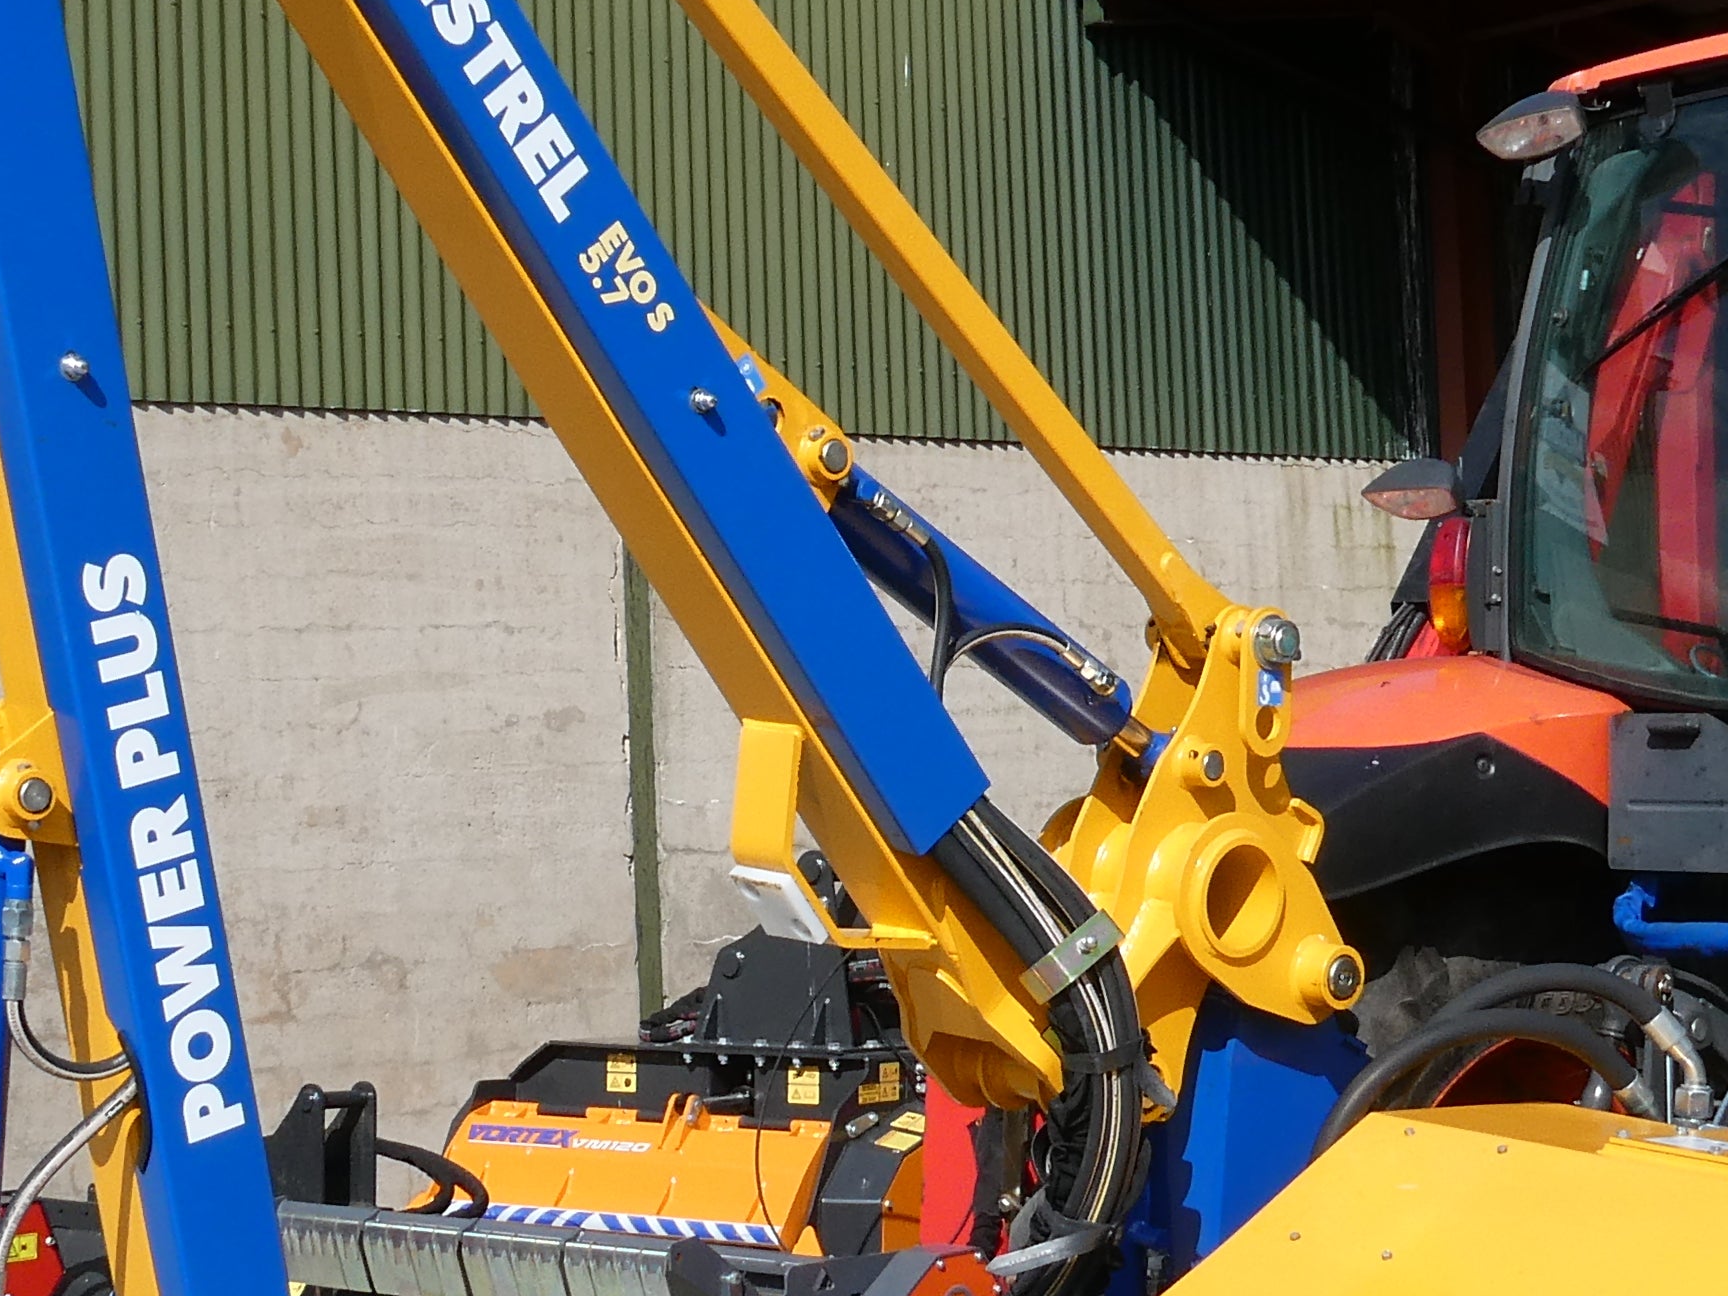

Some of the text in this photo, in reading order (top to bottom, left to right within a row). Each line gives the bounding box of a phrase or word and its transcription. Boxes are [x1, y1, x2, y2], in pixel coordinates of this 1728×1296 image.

[579, 242, 629, 304] 5.7
[597, 221, 657, 304] EVO
[83, 553, 245, 1144] POWER PLUS
[468, 1124, 652, 1152] VORTEX VM120
